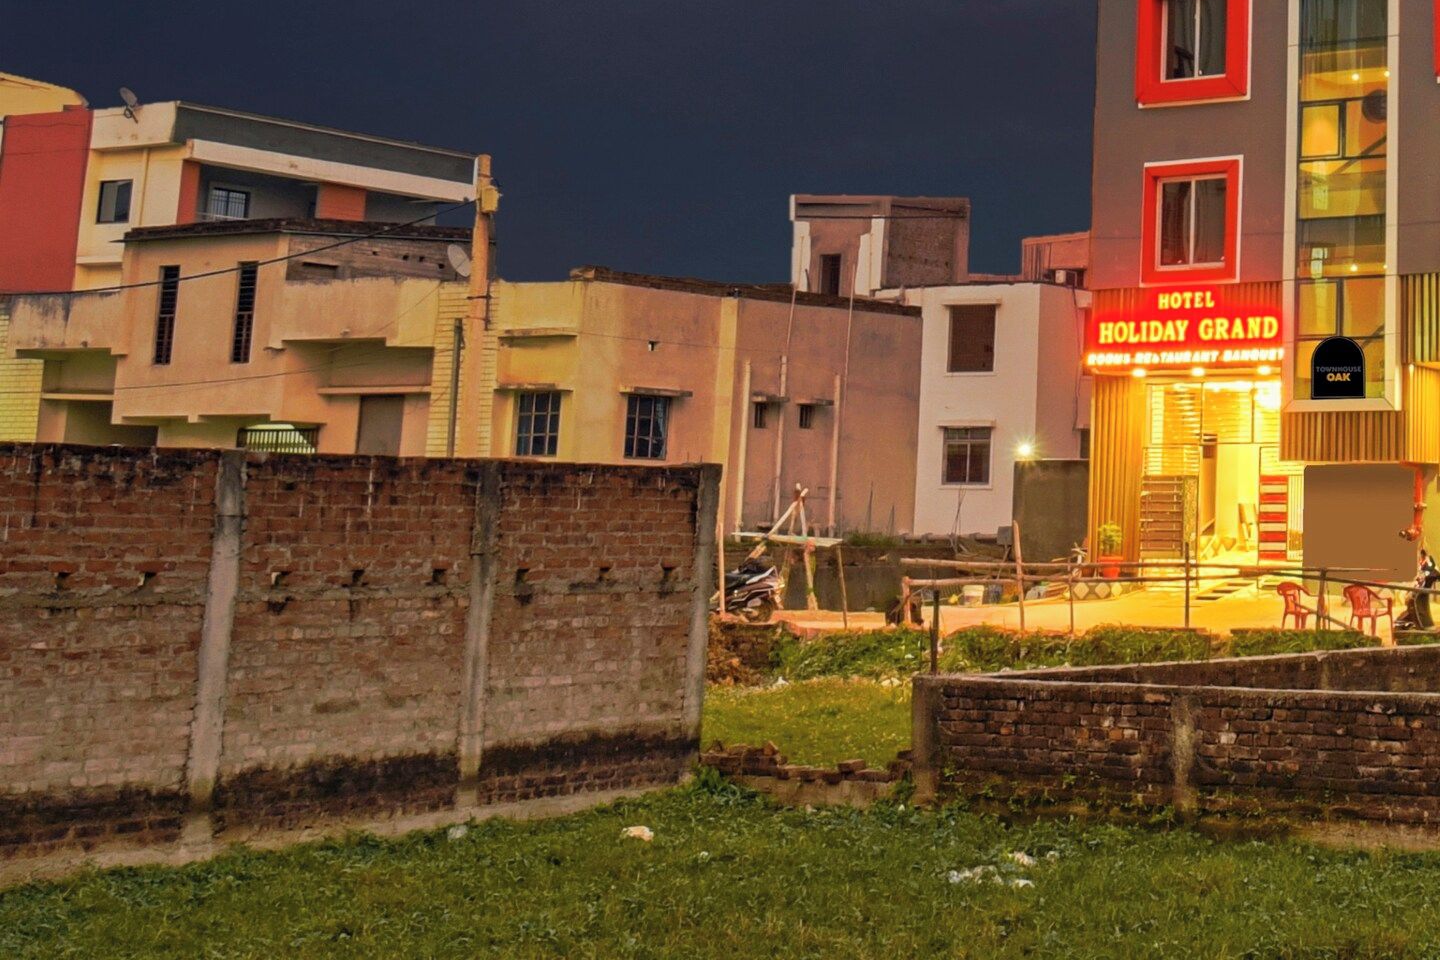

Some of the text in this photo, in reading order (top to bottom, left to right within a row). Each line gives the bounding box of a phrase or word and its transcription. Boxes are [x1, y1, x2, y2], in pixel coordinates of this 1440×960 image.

[1158, 291, 1215, 309] HOTEL
[1098, 316, 1279, 344] HOLIDAY GRAND
[1087, 347, 1285, 366] ROOMS RESTAURANT BANQUET
[1326, 373, 1351, 382] OAK
